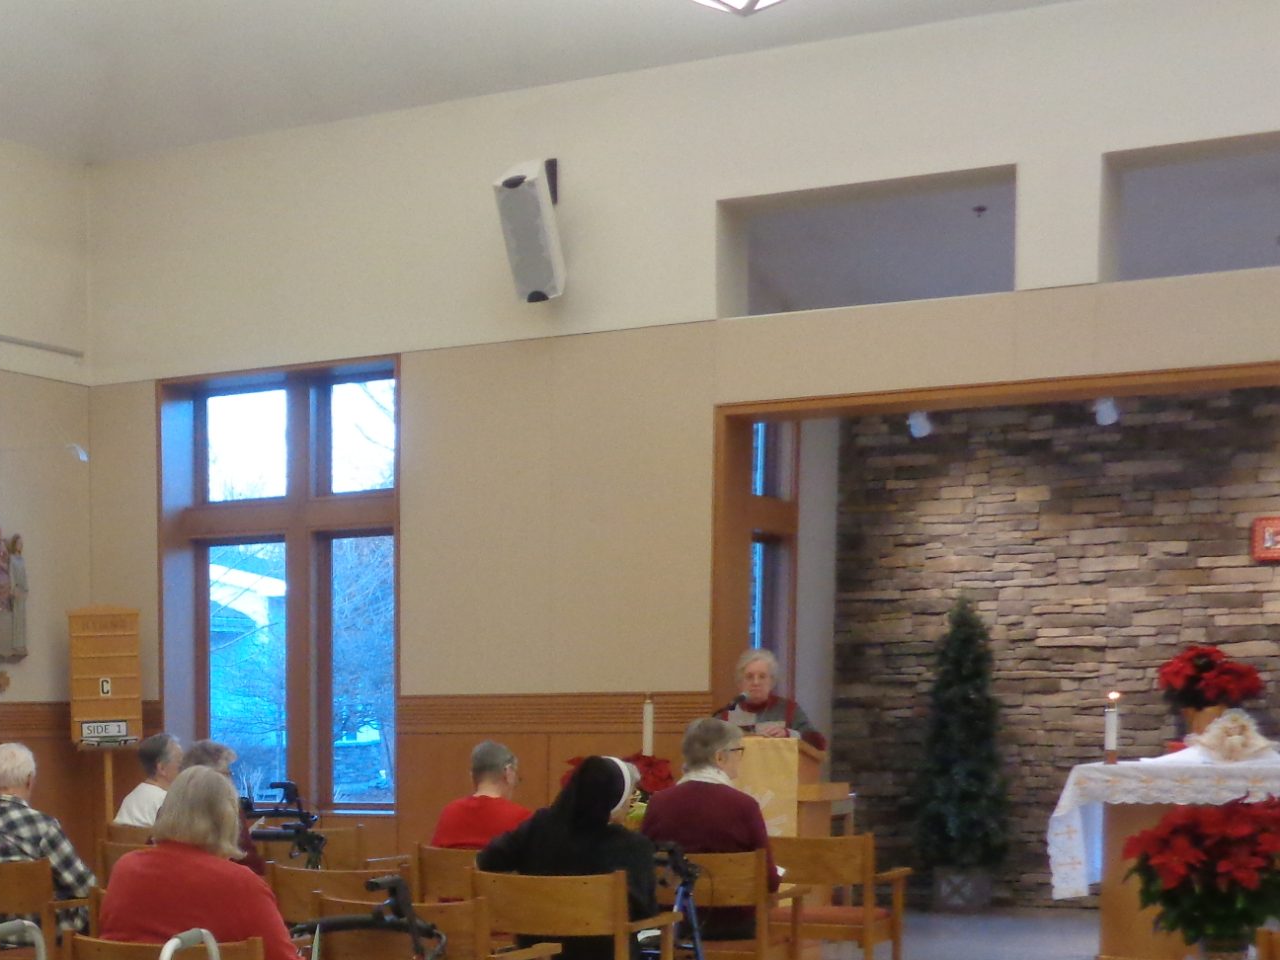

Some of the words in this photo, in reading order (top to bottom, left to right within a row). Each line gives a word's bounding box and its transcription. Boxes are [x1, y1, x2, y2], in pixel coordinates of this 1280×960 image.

[101, 679, 110, 695] C
[86, 725, 110, 735] SIDE
[116, 725, 122, 734] 1
